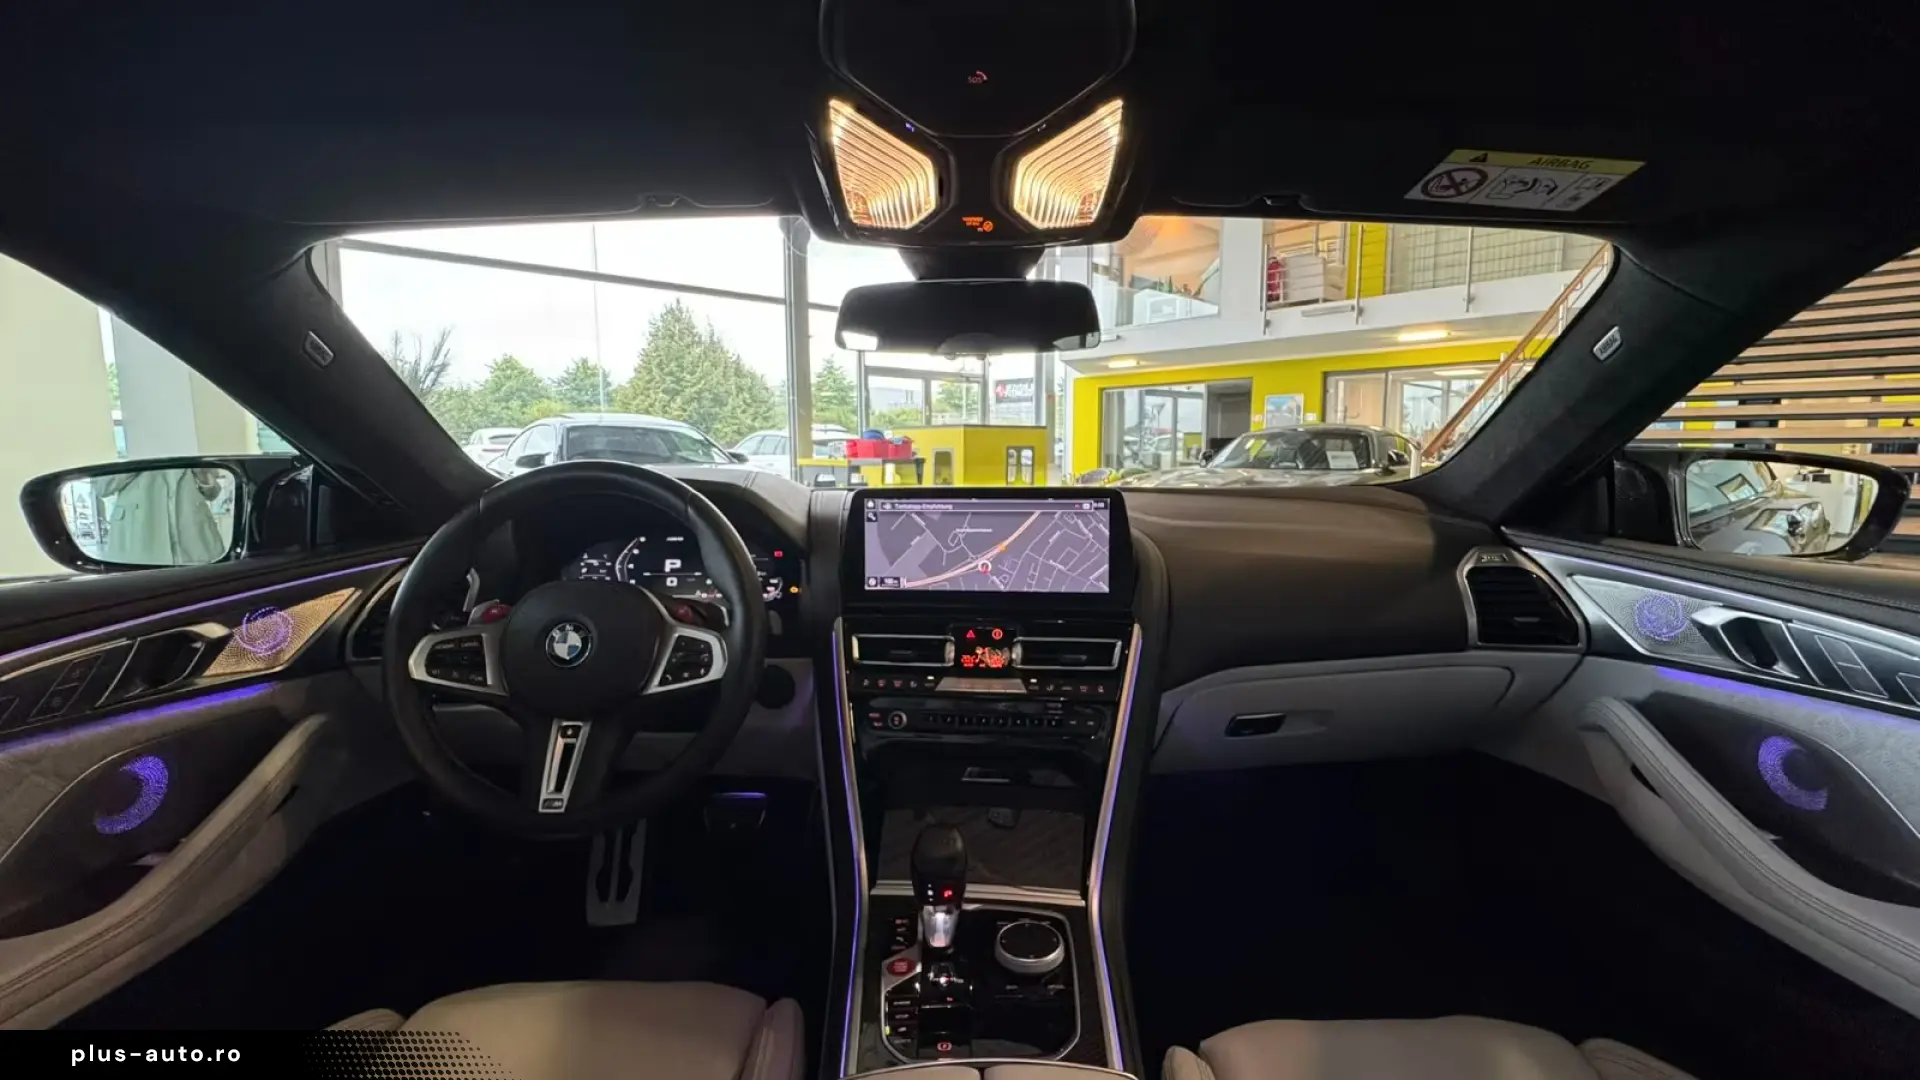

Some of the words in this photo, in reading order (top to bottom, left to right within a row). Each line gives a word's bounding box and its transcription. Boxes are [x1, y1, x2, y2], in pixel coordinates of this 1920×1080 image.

[967, 76, 982, 84] SOS
[1529, 155, 1595, 169] AIRBAG
[665, 559, 681, 572] P
